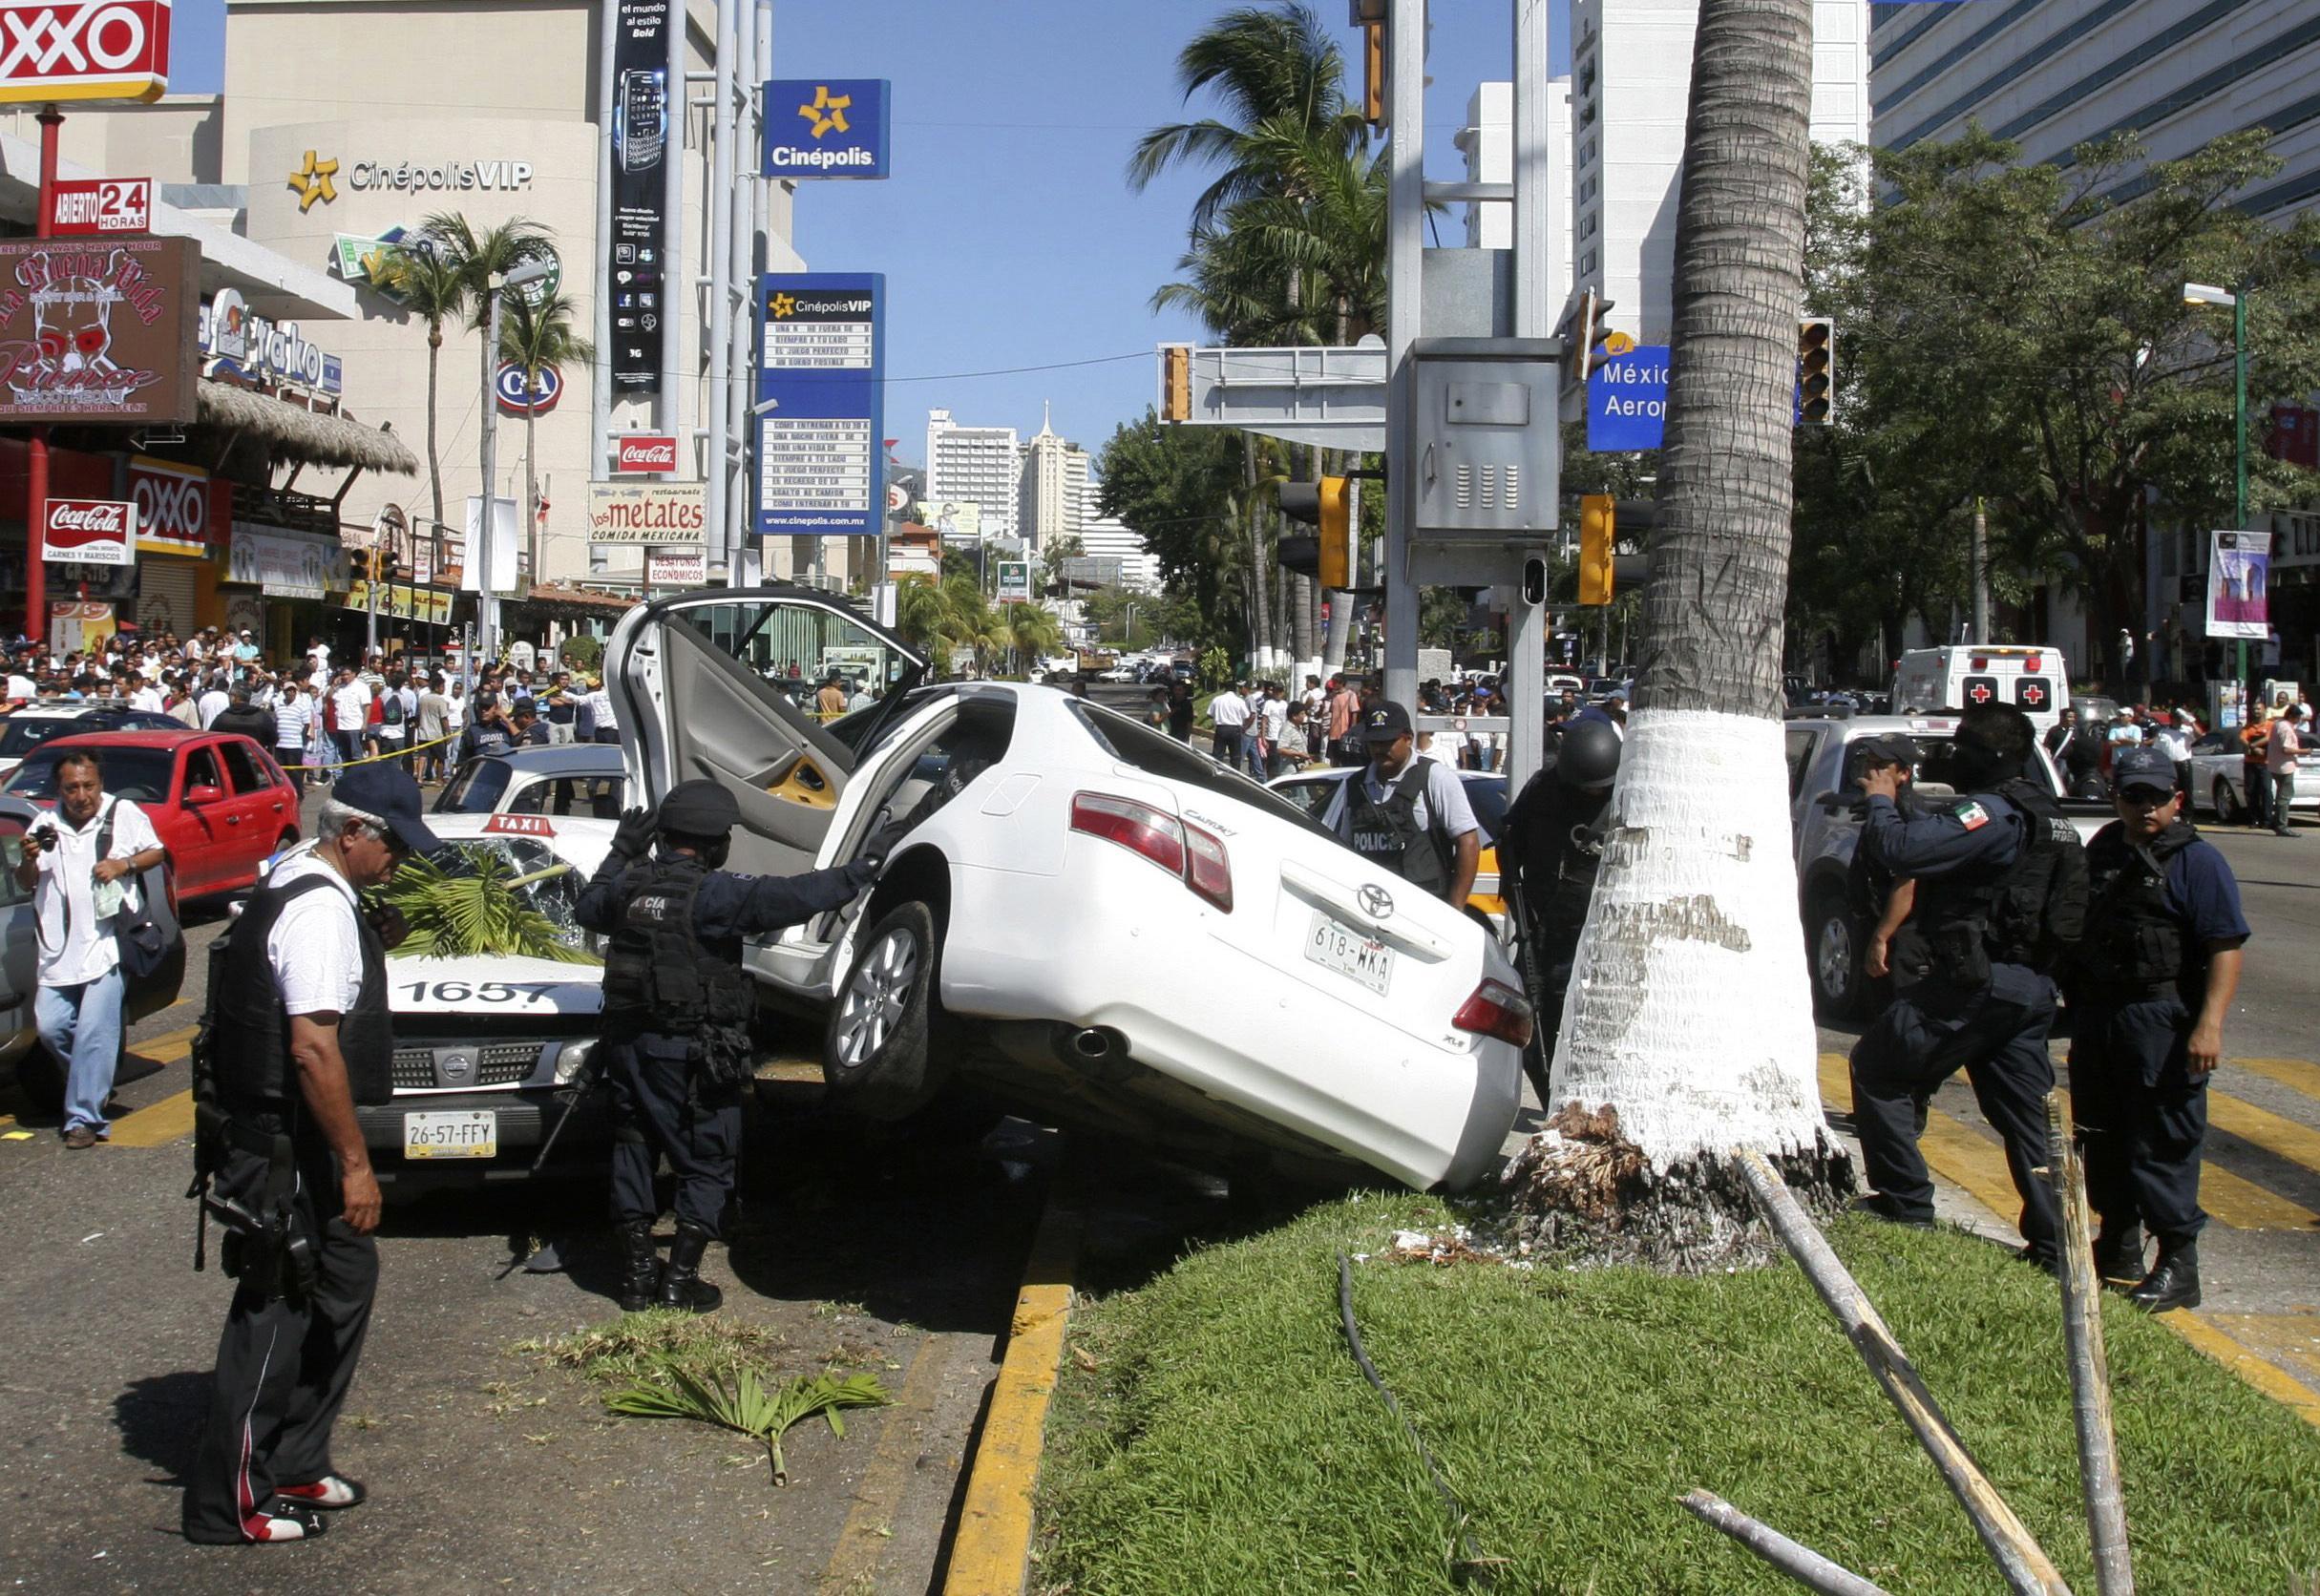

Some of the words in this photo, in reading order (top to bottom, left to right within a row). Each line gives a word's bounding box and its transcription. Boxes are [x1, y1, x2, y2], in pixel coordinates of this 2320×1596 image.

[622, 4, 631, 13] el
[632, 2, 666, 13] mundo
[626, 16, 636, 26] al
[637, 15, 662, 26] estilo
[0, 3, 144, 77] XXO
[632, 28, 656, 38] Bold
[772, 147, 872, 170] Cinépolis
[54, 192, 98, 224] ABIERTO
[100, 185, 145, 215] 24
[100, 216, 145, 230] HORAS
[127, 241, 162, 251] HOUR
[17, 252, 107, 294] Buena
[1603, 361, 1669, 384] Méxic
[622, 445, 674, 463] Coca-Cola
[134, 476, 202, 536] OXXO
[590, 512, 610, 528] los
[608, 497, 703, 529] metates
[50, 504, 124, 532] Coca-Cola
[765, 516, 865, 526] www.cinepolis.com.mx
[591, 531, 636, 540] COMIDA
[641, 531, 700, 541] MEXICANA
[48, 551, 75, 559] CARNES
[84, 552, 120, 560] MARISCOS
[655, 556, 702, 567] DESAYUNOS
[498, 816, 540, 832] TAXI
[1184, 809, 1238, 837] Camry
[1353, 832, 1401, 850] POLIC
[1316, 927, 1387, 979] 618-WKA
[398, 981, 559, 1002] 1657
[411, 1124, 490, 1144] 26-57-FFY
